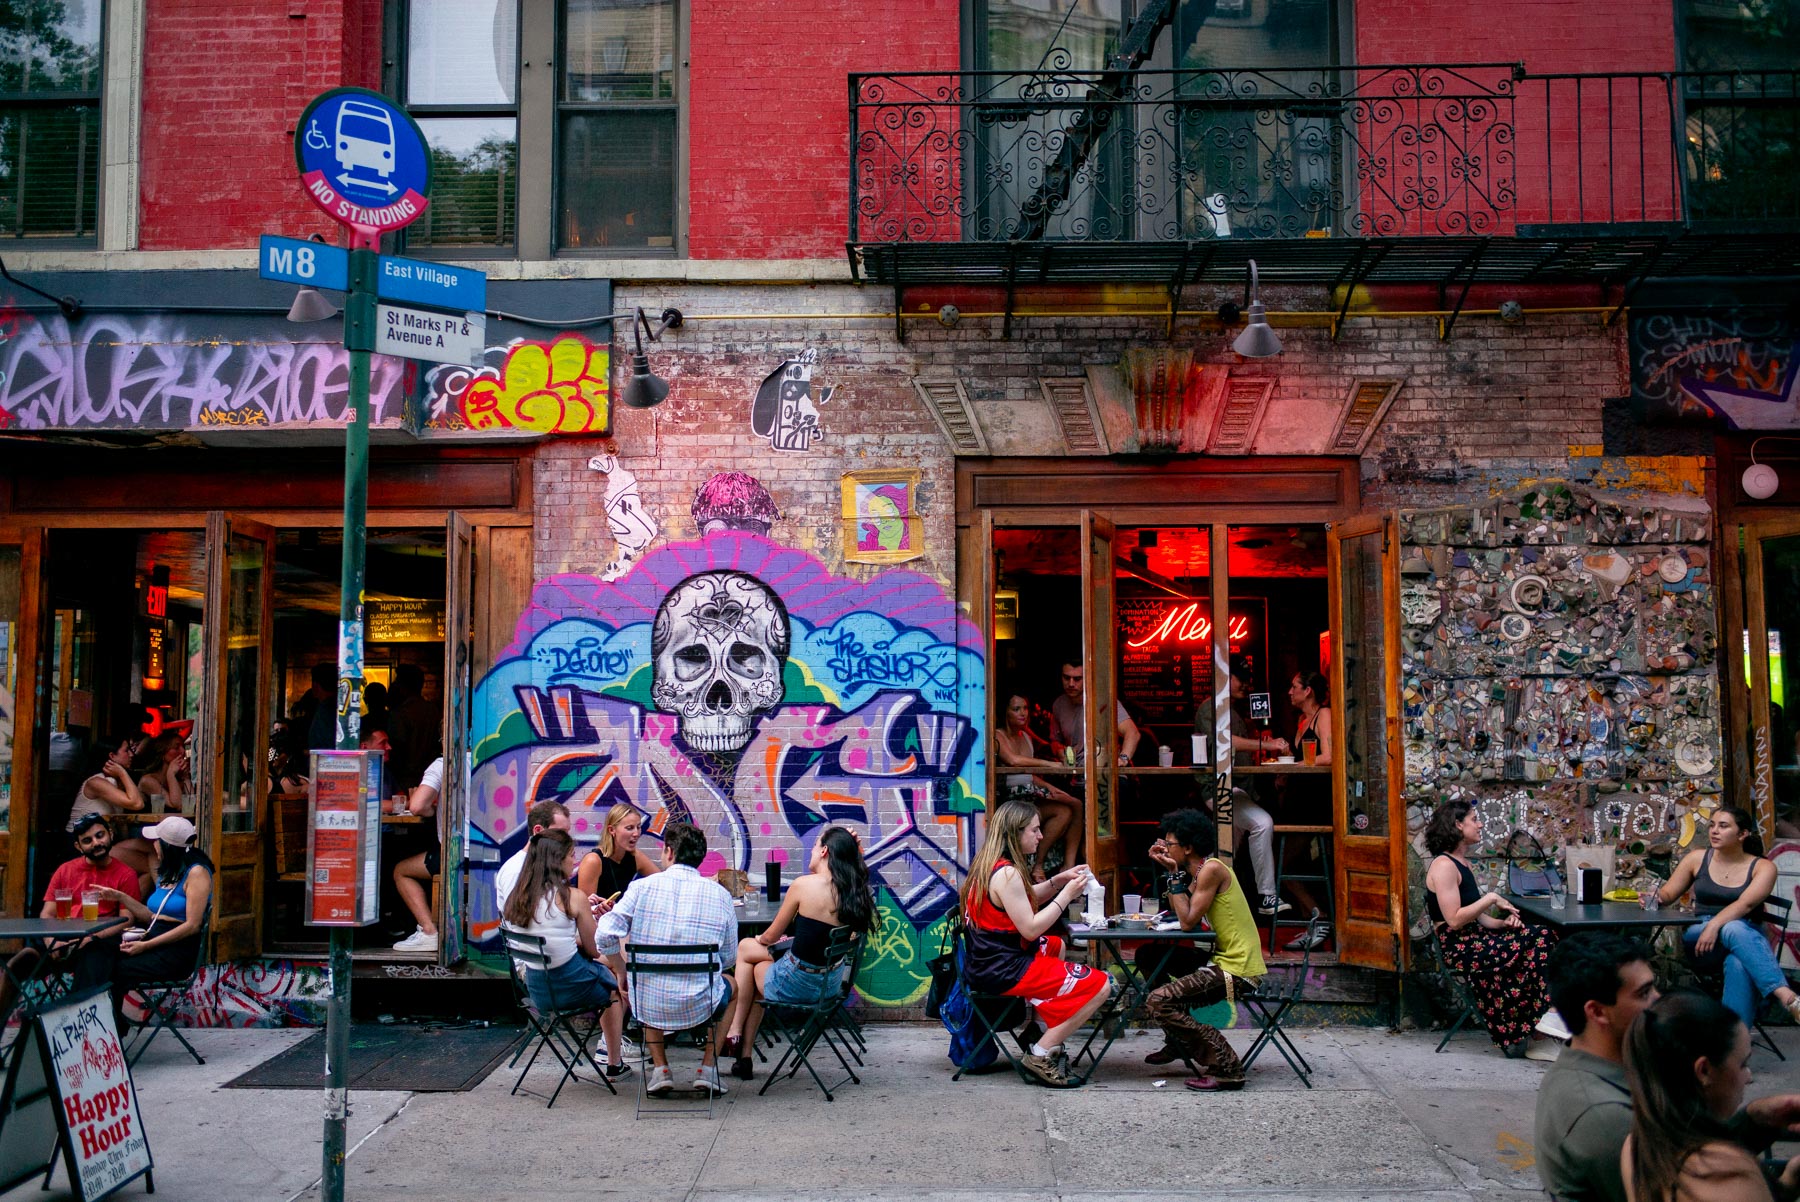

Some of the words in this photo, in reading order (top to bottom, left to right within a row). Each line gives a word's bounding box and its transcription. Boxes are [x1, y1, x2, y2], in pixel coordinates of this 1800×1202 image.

[310, 179, 335, 205] NO
[337, 198, 417, 226] STANDING
[269, 246, 316, 279] M8
[385, 261, 412, 279] East
[416, 266, 458, 288] Village
[387, 310, 401, 326] St
[404, 313, 441, 332] Marks
[445, 319, 457, 335] Pl
[461, 322, 470, 336] &
[387, 327, 432, 346] Avenue
[436, 334, 444, 348] A
[147, 585, 168, 617] EXIT
[1142, 645, 1160, 654] TACOS
[1252, 700, 1269, 710] 154
[1593, 793, 1674, 845] 1987
[51, 1035, 69, 1077] AL
[63, 1004, 108, 1049] PASTOR
[64, 1080, 130, 1128] Happy
[79, 1114, 132, 1160] Hour
[82, 1159, 108, 1181] Monday
[107, 1148, 124, 1166] Thru
[124, 1136, 145, 1158] Friday
[107, 1161, 127, 1184] 7PM
